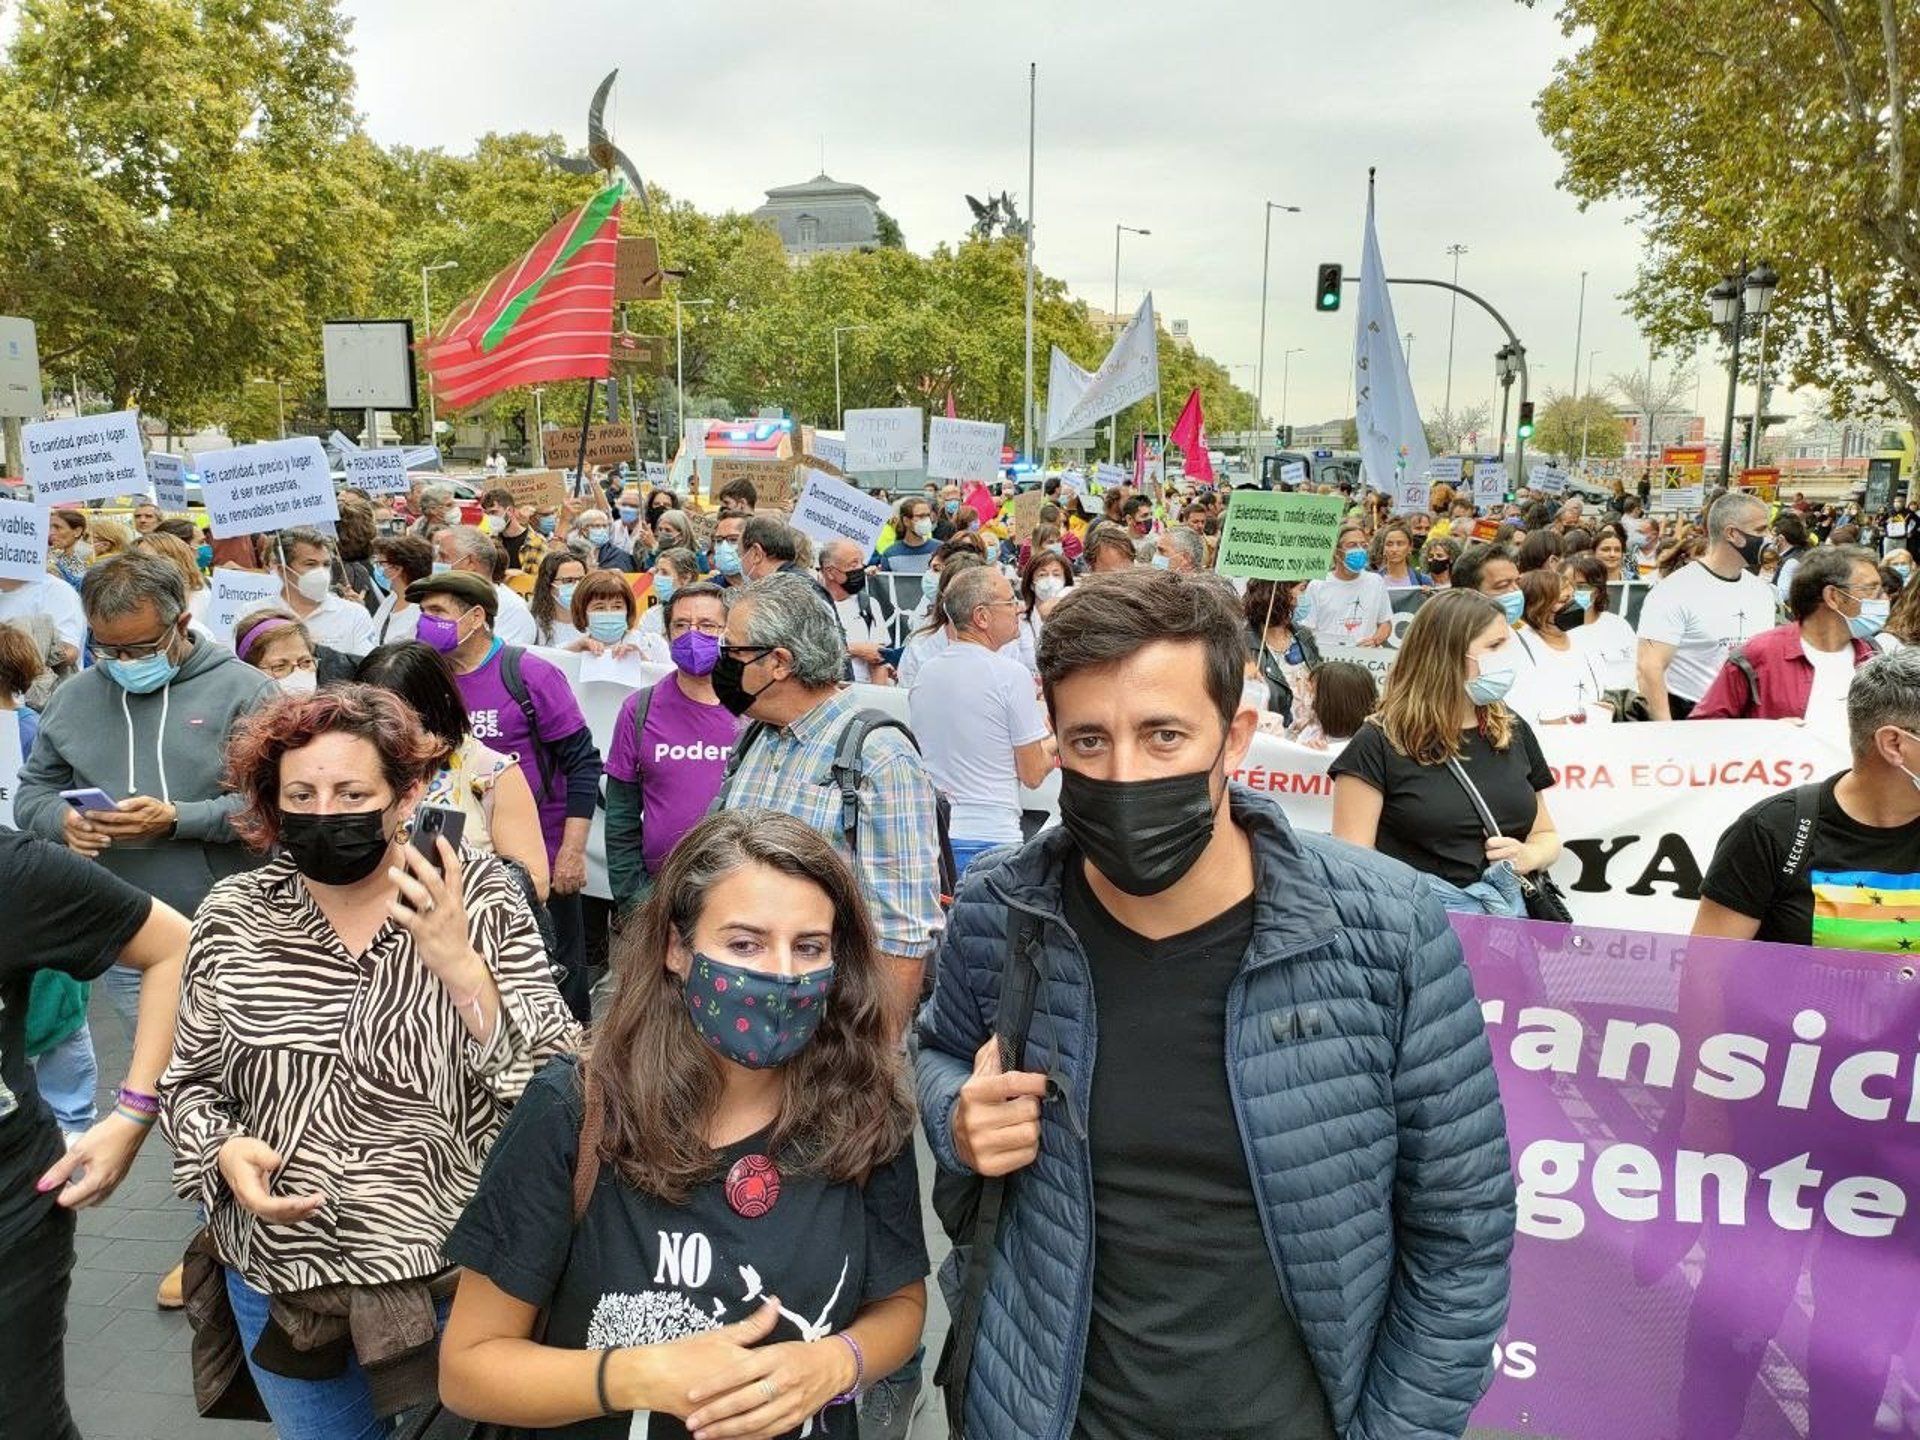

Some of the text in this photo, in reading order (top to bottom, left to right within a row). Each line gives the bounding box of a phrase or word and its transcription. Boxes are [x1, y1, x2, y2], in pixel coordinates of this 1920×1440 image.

[204, 470, 218, 483] En
[258, 458, 283, 477] precio
[214, 511, 228, 525] las
[229, 504, 275, 523] renovables
[274, 500, 291, 513] han
[292, 499, 302, 510] de
[0, 516, 37, 540] vables,
[219, 584, 279, 601] Democrati
[1630, 757, 1814, 789] EÓLICAS?
[1783, 818, 1812, 874] SKECHERS
[654, 1230, 712, 1288] NO
[1491, 1341, 1537, 1379] s
